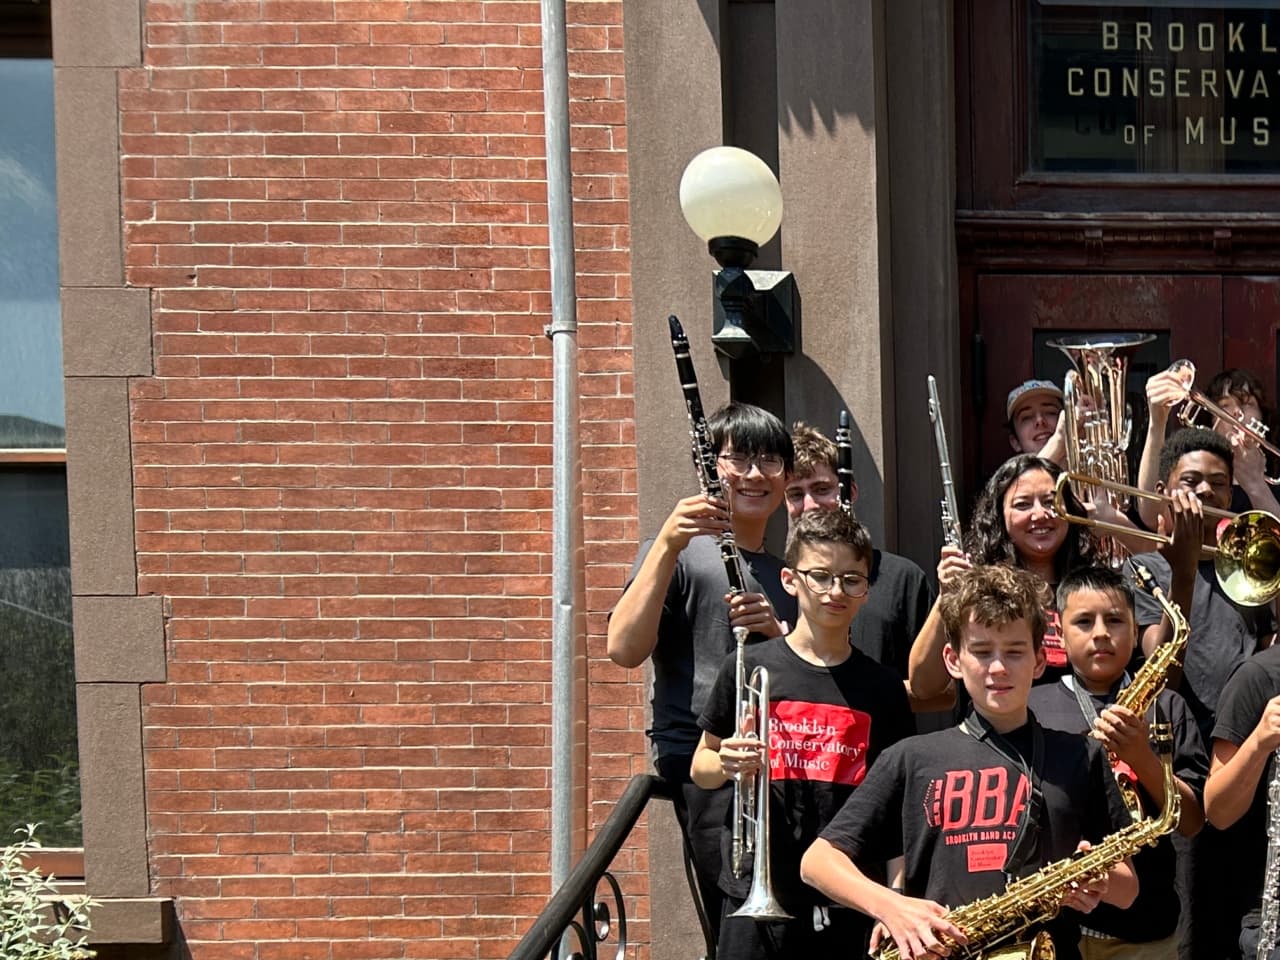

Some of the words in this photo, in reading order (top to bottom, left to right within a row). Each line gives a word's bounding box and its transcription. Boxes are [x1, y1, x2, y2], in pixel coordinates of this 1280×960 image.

[1123, 124, 1155, 145] OF
[768, 717, 836, 738] Brooklyn
[768, 734, 861, 762] Conservatory
[770, 752, 781, 769] of
[785, 752, 830, 771] Music
[942, 766, 1030, 832] BBA
